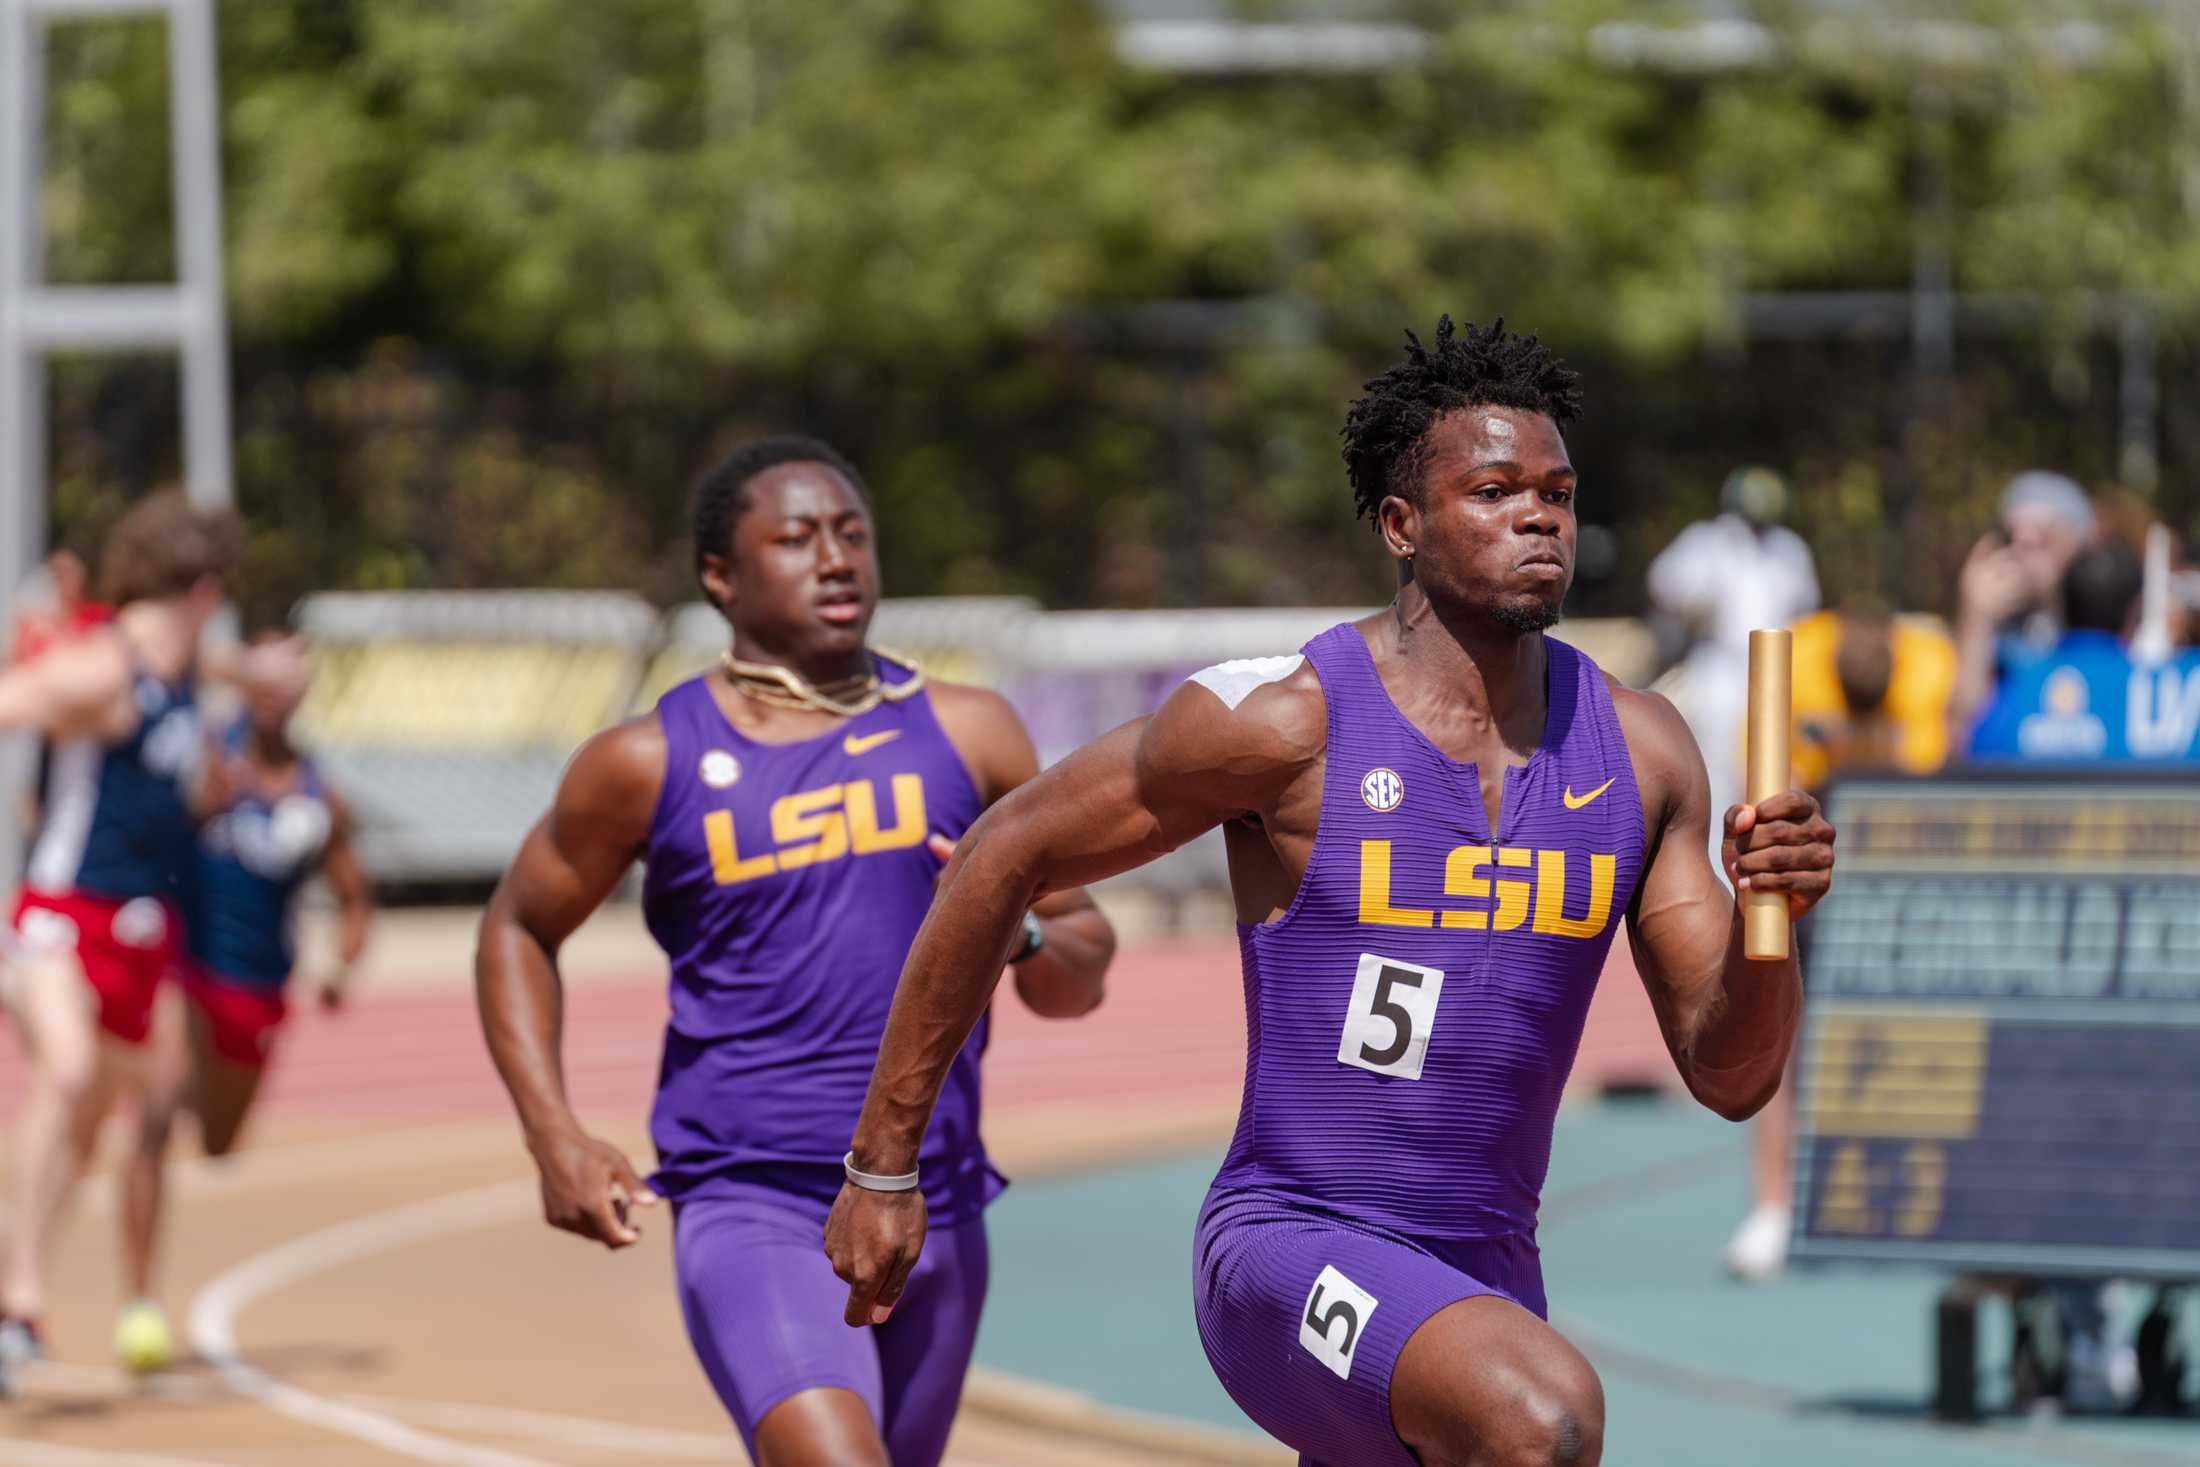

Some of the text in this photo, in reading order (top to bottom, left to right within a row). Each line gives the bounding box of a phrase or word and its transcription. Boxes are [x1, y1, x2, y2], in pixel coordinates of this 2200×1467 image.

[704, 773, 928, 886] LSU
[1363, 770, 1402, 810] SEC
[1358, 840, 1616, 939] LSU
[1359, 964, 1424, 1066] 5
[1305, 1283, 1358, 1357] 5
